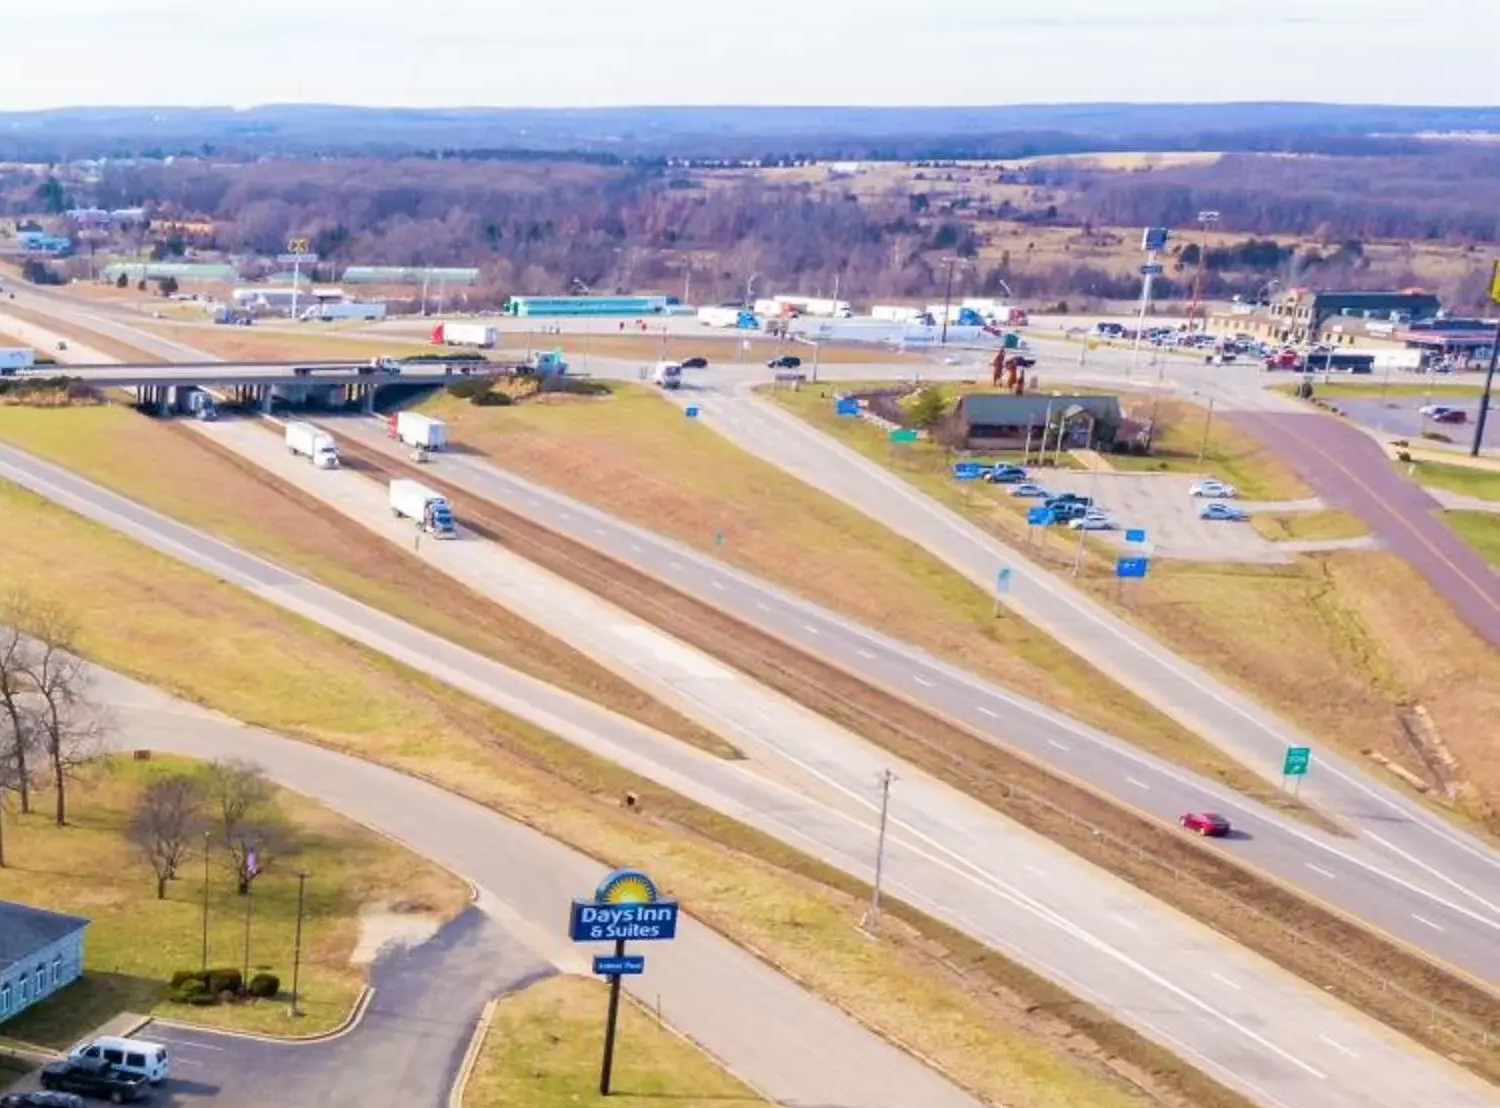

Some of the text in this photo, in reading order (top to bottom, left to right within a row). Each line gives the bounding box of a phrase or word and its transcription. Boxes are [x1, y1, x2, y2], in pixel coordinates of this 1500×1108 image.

[581, 907, 672, 926] Days Inn
[590, 923, 660, 938] & Suites
